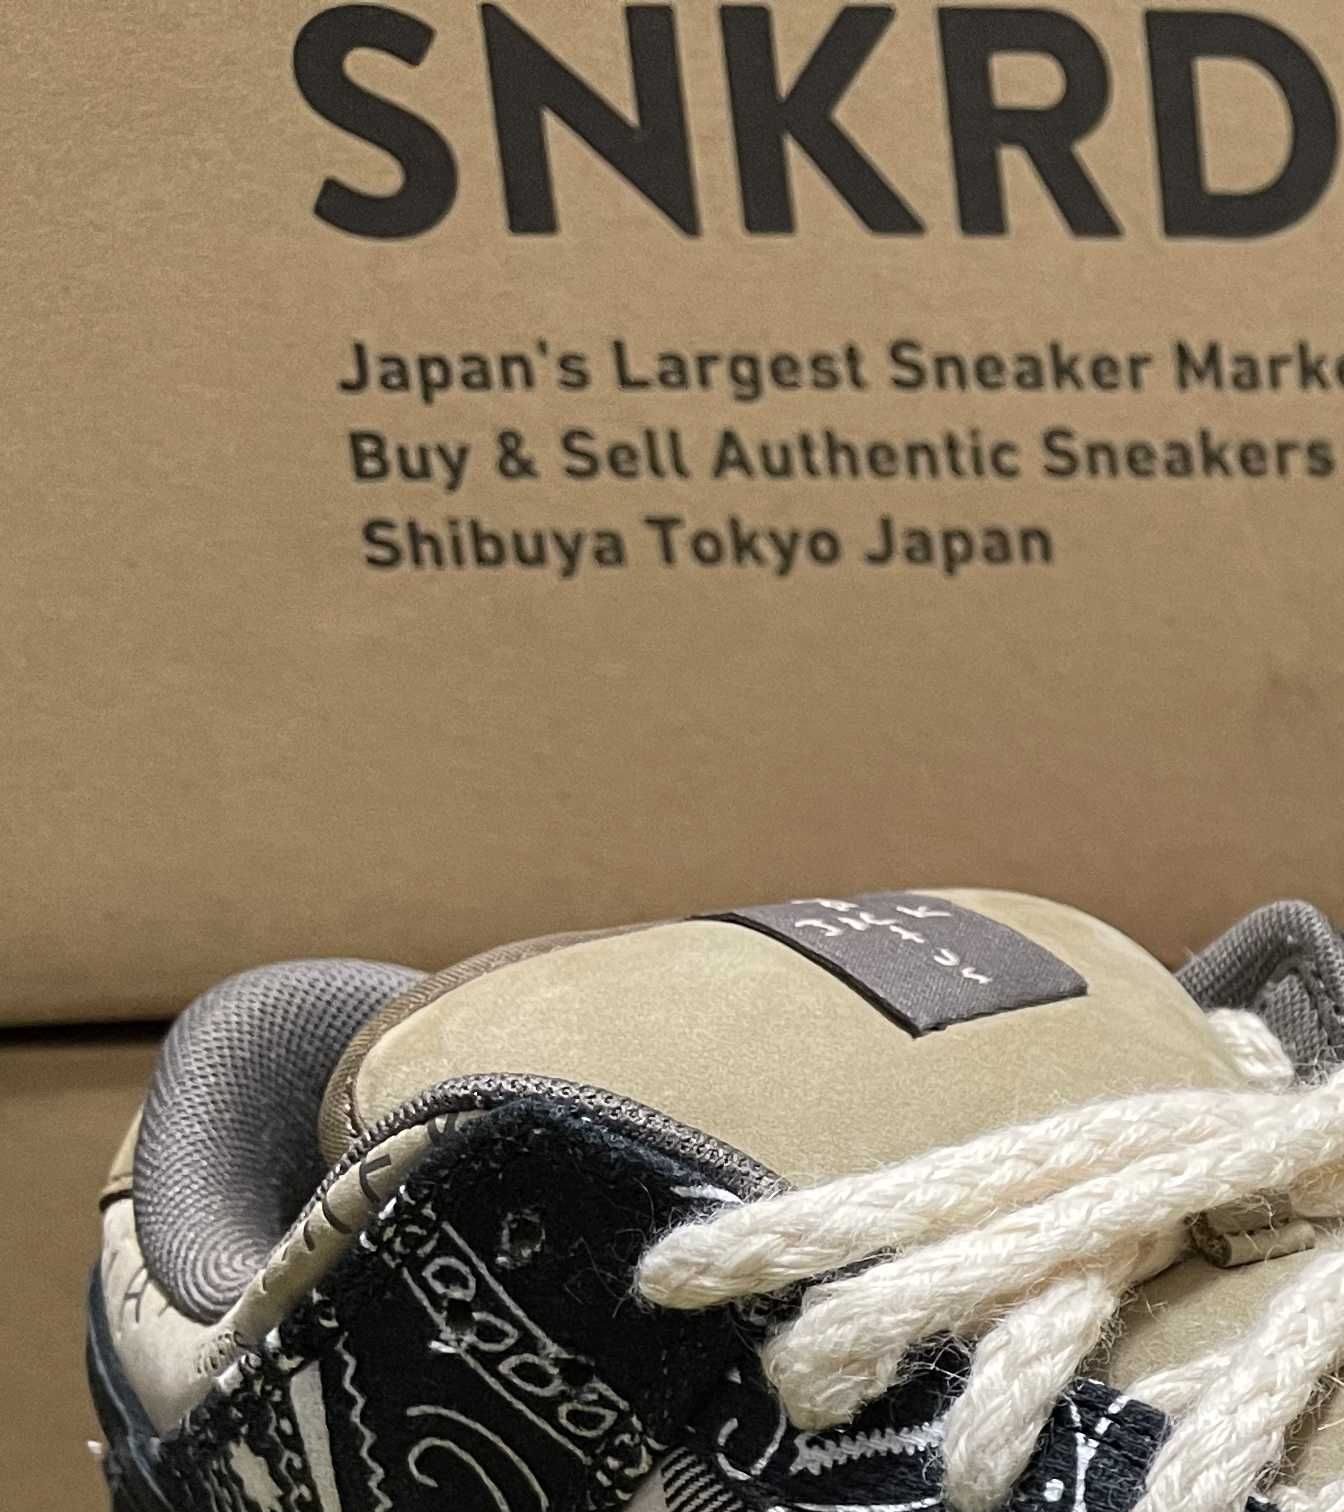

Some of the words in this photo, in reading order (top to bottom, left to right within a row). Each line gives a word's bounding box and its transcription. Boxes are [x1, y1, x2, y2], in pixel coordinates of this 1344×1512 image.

[338, 339, 592, 404] Japan's
[611, 339, 868, 402] Largest
[888, 338, 1153, 392] Sneaker
[348, 429, 471, 493] Buy
[495, 428, 540, 481] &
[560, 428, 692, 481] Sell
[711, 428, 1021, 480] Authentic
[1041, 427, 1336, 480] Sneakers
[361, 515, 627, 580] Shibuya
[643, 515, 841, 578] Tokyo
[863, 514, 1054, 578] Japan
